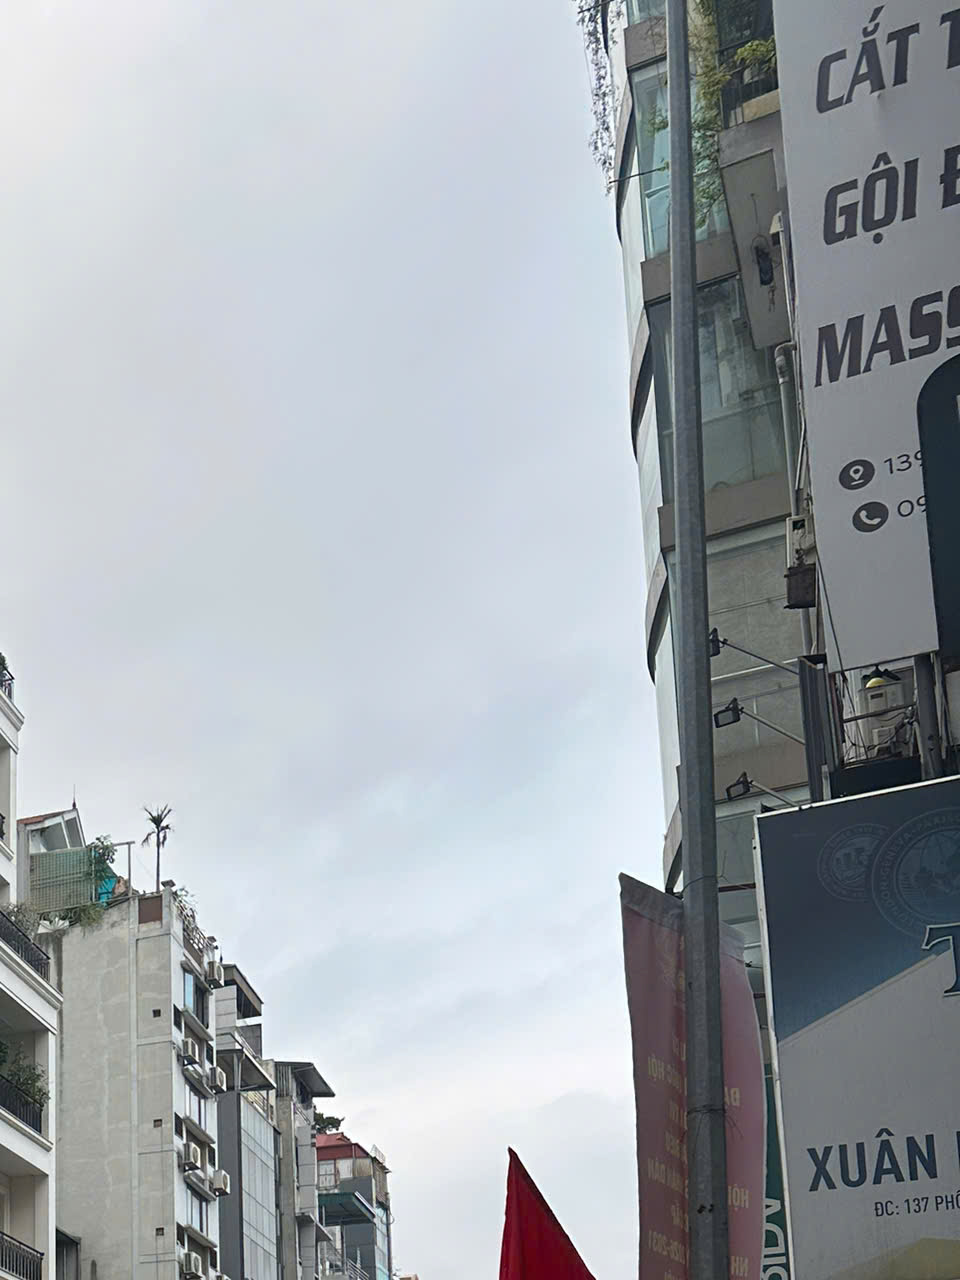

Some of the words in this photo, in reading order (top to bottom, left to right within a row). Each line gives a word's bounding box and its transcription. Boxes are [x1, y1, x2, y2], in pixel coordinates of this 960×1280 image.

[816, 5, 921, 114] CẮT
[823, 150, 921, 247] GỘI
[806, 1128, 938, 1192] XUÂN
[874, 1201, 900, 1217] ĐC:
[904, 1197, 929, 1215] 137
